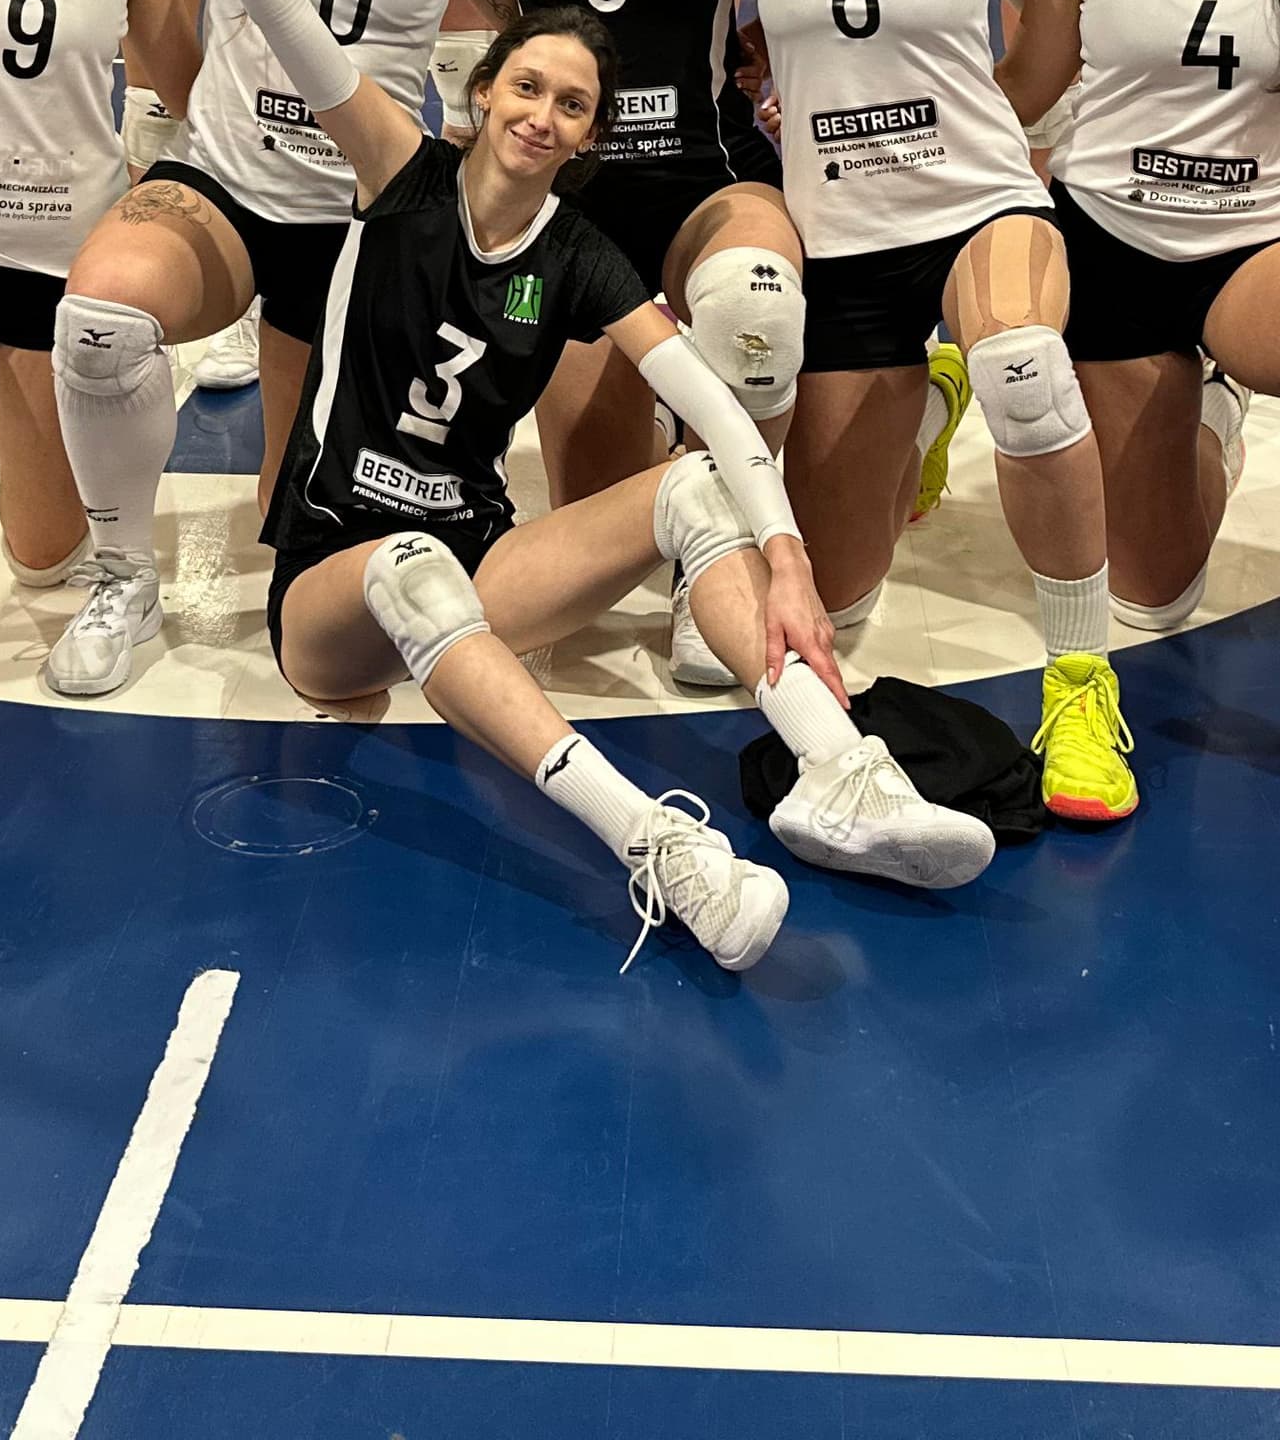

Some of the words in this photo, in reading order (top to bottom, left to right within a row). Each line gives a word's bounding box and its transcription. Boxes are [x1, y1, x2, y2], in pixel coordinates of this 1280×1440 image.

[1181, 0, 1240, 91] 4
[261, 96, 311, 122] BEST
[615, 94, 670, 115] RENT
[816, 104, 929, 138] BESTRENT
[637, 135, 682, 152] správa
[868, 130, 939, 150] MECHANIZÁCIE
[843, 152, 899, 171] Domová
[902, 145, 945, 164] správa
[1138, 152, 1254, 182] BESTRENT
[28, 199, 72, 215] správa
[409, 321, 487, 423] 3
[361, 457, 458, 502] BESTRENT
[352, 484, 399, 510] PRENÁJOM
